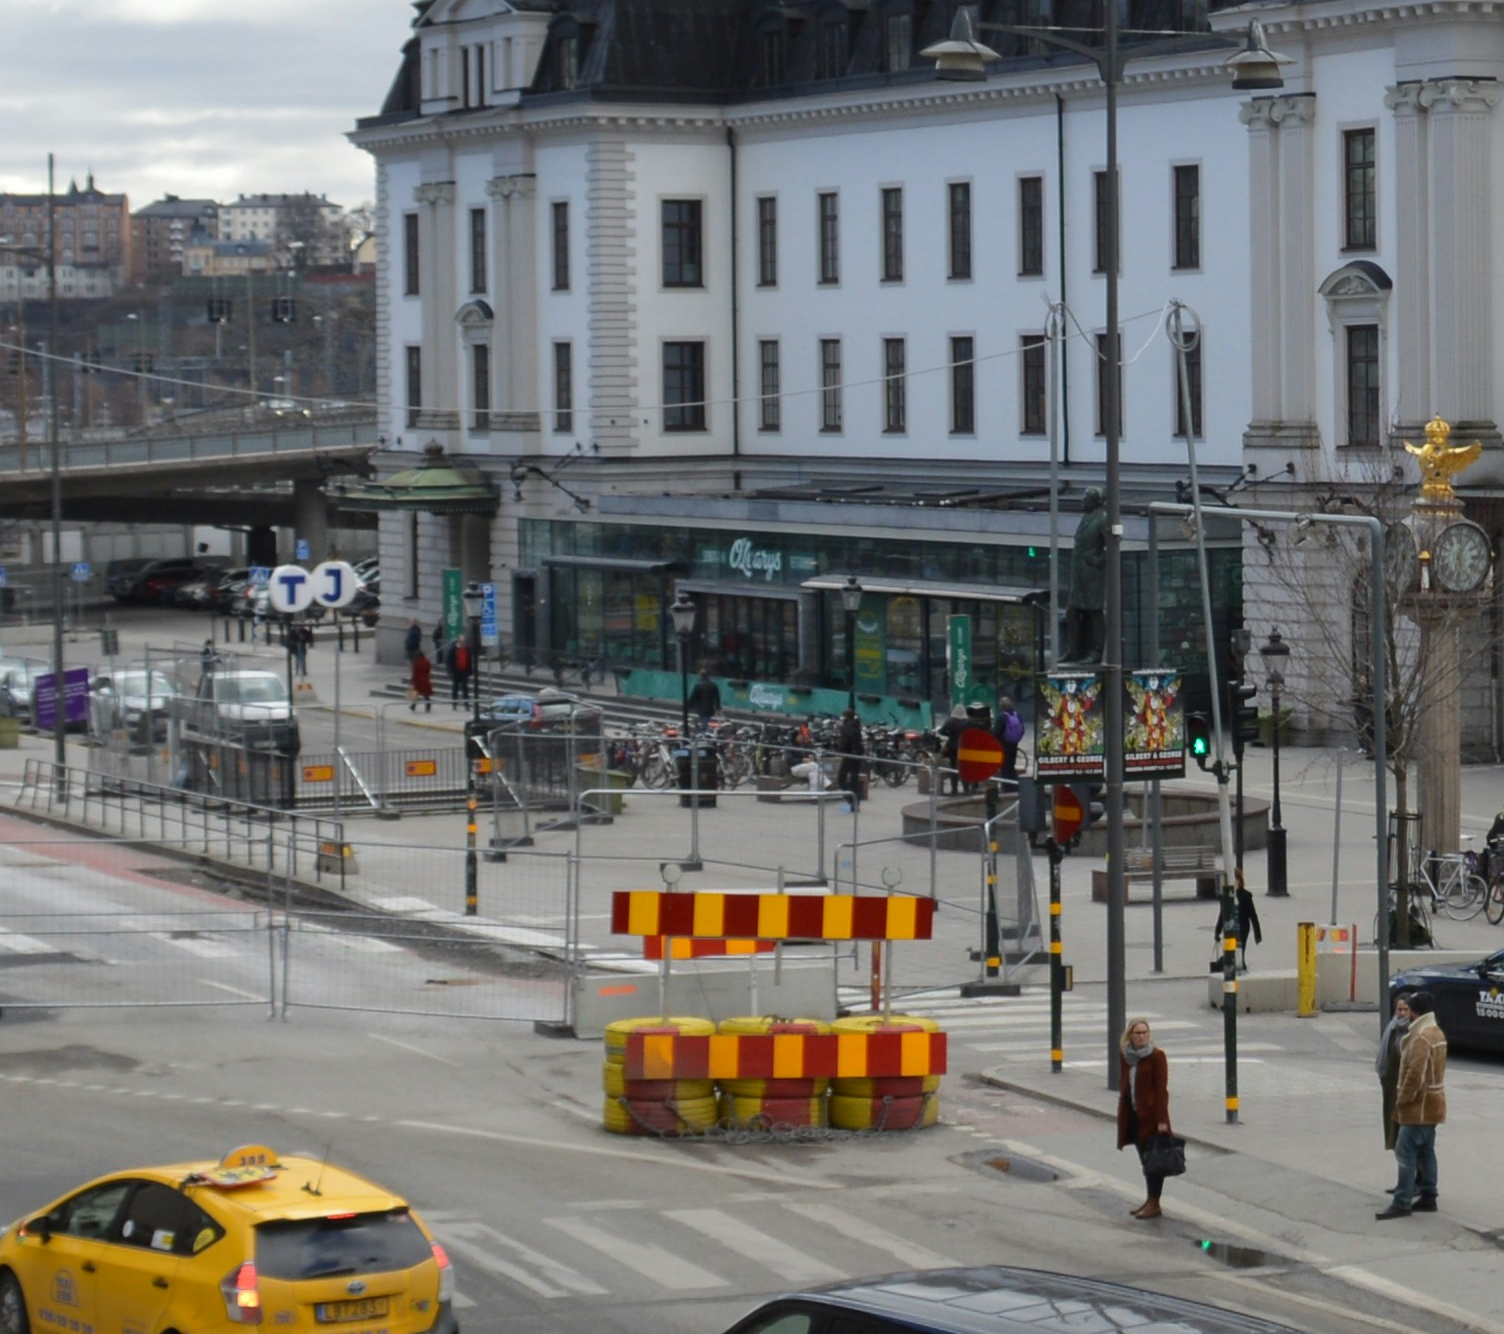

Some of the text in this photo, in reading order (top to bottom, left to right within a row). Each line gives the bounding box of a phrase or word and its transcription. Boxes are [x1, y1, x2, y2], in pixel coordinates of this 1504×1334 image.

[279, 575, 306, 605] T
[322, 569, 341, 602] J
[1038, 756, 1067, 764] GILBERT
[1076, 755, 1103, 763] GEORGE
[1125, 752, 1151, 760] GILBERT
[1159, 750, 1182, 759] GEORGE
